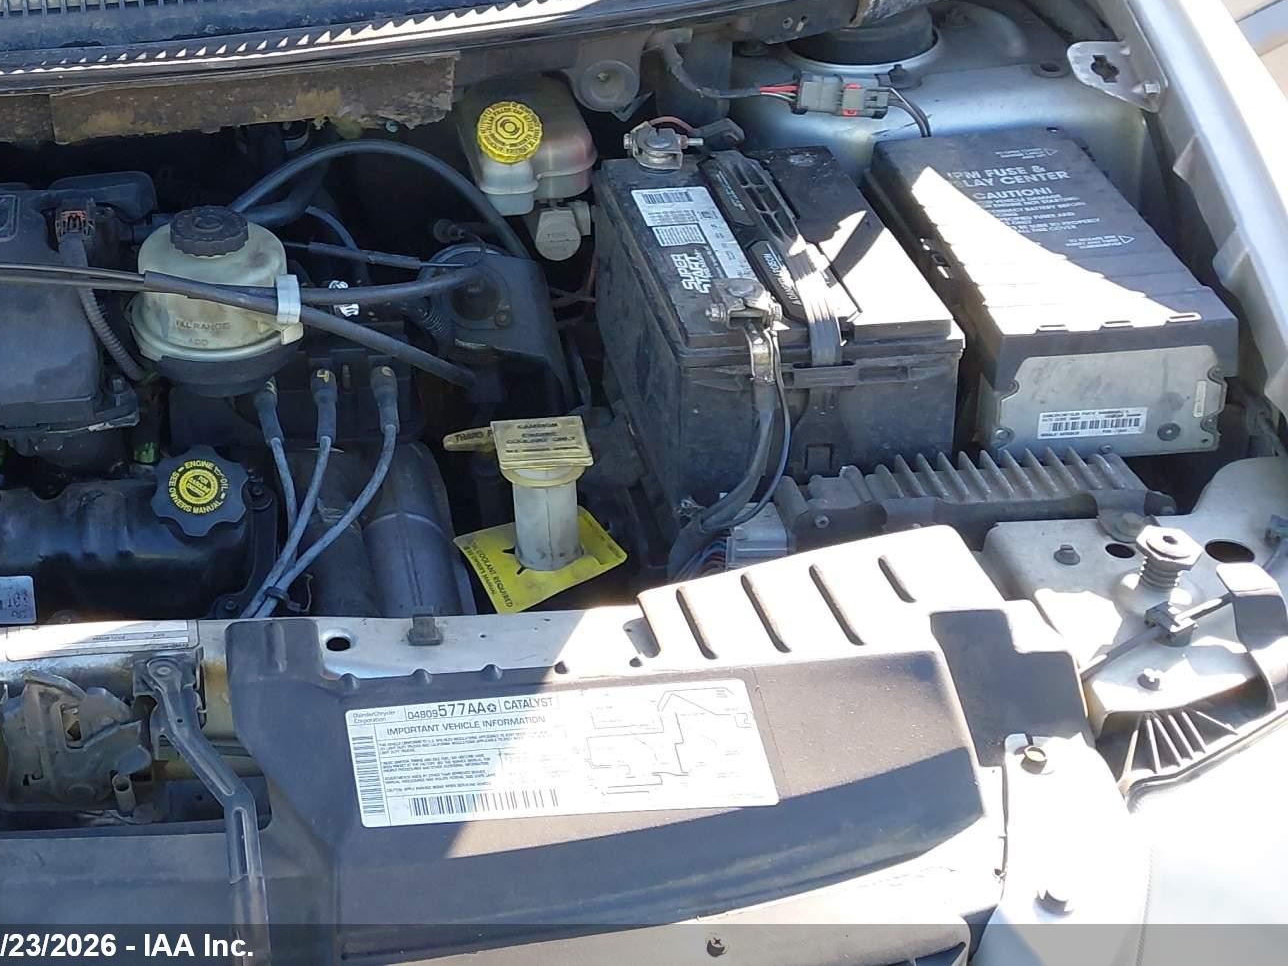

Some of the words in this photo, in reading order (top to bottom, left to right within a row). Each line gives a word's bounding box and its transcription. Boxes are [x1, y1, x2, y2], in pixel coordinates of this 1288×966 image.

[986, 166, 1025, 178] FUSE
[1031, 165, 1046, 174] &
[1000, 171, 1071, 185] CENTER
[973, 187, 1052, 201] CAUTION!
[670, 253, 695, 290] SUPER
[686, 254, 712, 294] START
[184, 460, 215, 470] ENGINE
[220, 478, 229, 491] OIL
[168, 471, 179, 487] SEE
[192, 498, 224, 514] MANUAL
[504, 697, 553, 711] CATALYST
[387, 724, 440, 736] IMPORTANT
[442, 720, 481, 731] VEHICLE
[482, 715, 546, 728] INFORMATION
